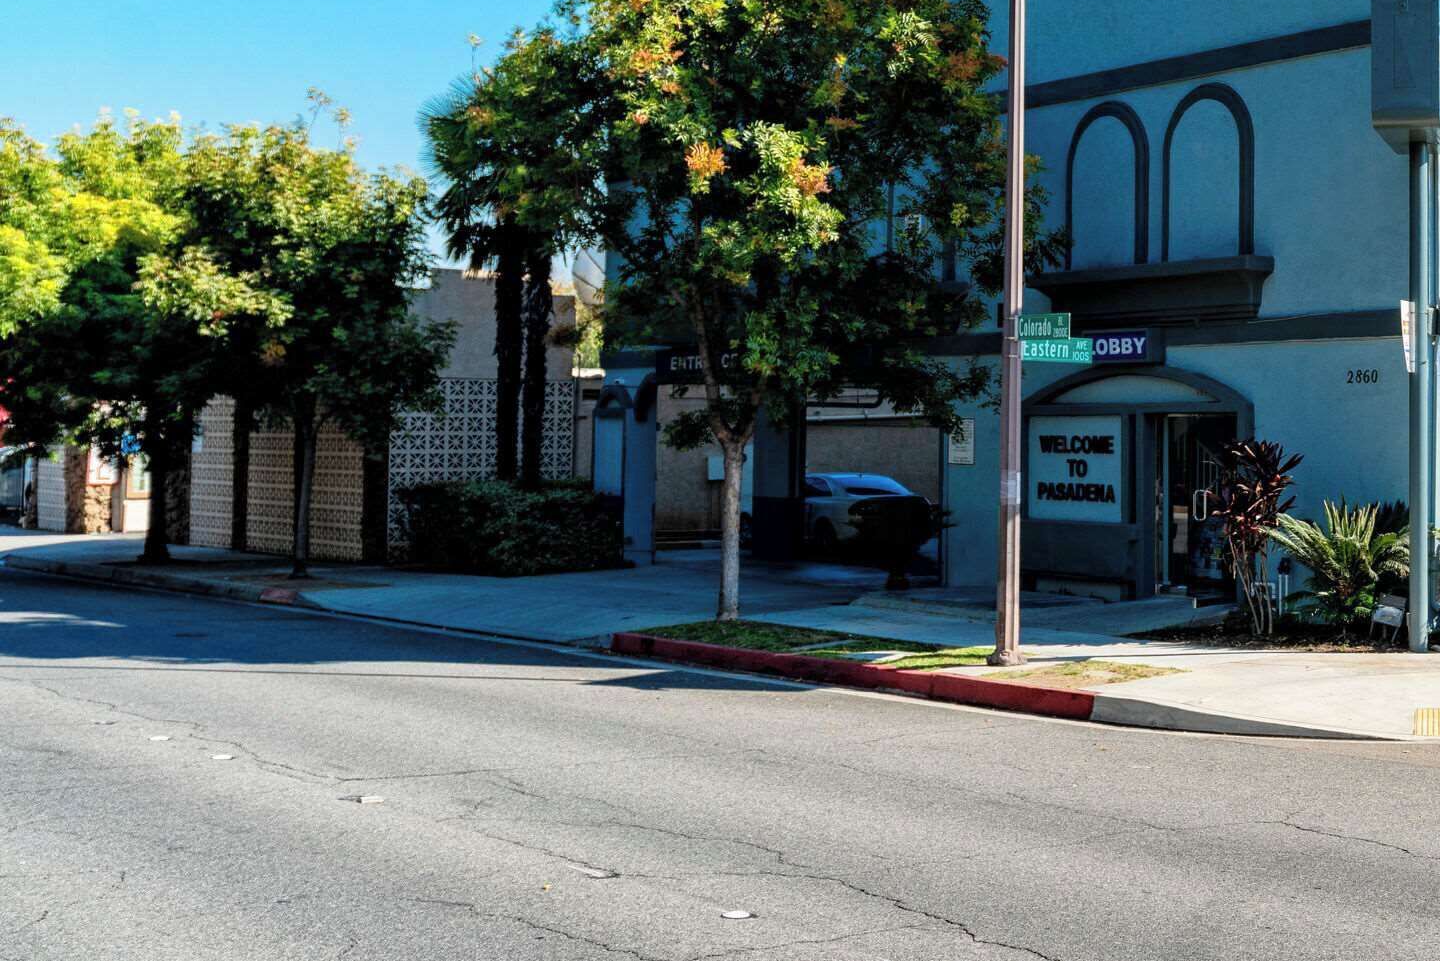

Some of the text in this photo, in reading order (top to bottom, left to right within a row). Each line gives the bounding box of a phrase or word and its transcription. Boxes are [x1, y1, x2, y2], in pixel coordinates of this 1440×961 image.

[1019, 317, 1052, 337] Colorado
[1023, 339, 1089, 358] Eastern AVE
[1092, 337, 1146, 356] OBBY
[669, 353, 739, 371] ENTRC
[1346, 368, 1378, 384] 2860
[1038, 435, 1115, 455] WELCOME
[1066, 458, 1089, 478] TO
[1037, 481, 1116, 504] PASADENA
